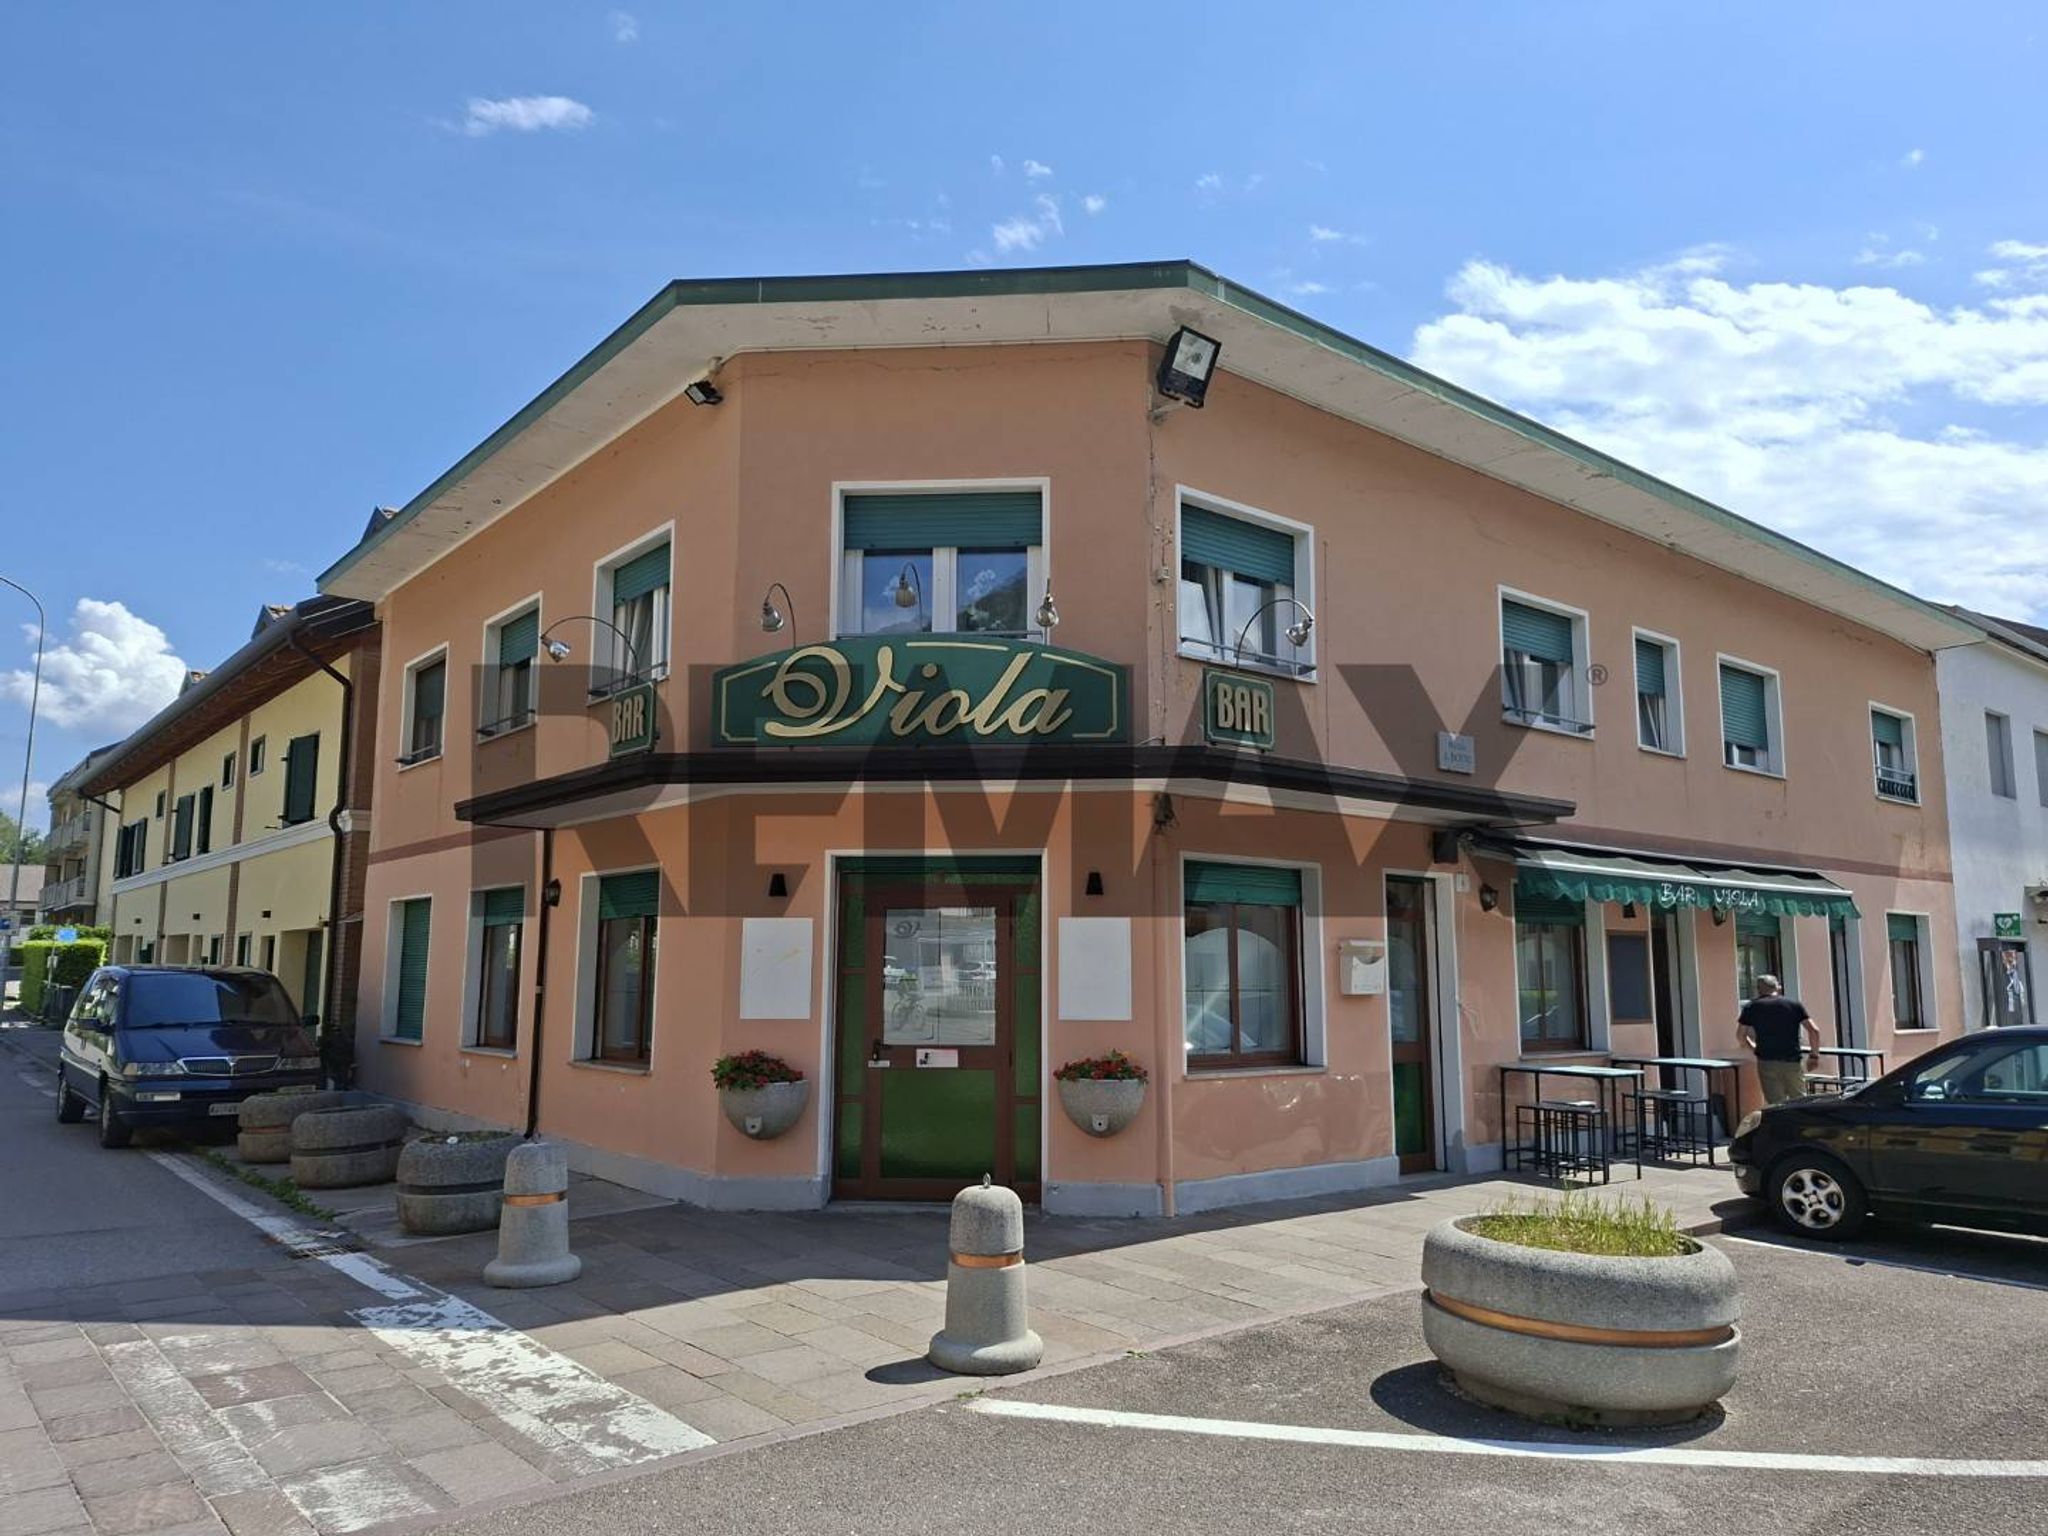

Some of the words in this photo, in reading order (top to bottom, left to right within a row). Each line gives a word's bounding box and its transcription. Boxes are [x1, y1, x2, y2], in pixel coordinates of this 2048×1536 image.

[762, 645, 1073, 738] Viola
[1217, 682, 1270, 735] BAR
[612, 694, 645, 743] BAR
[1661, 882, 1696, 903] BAR
[1713, 888, 1758, 907] VIOLA
